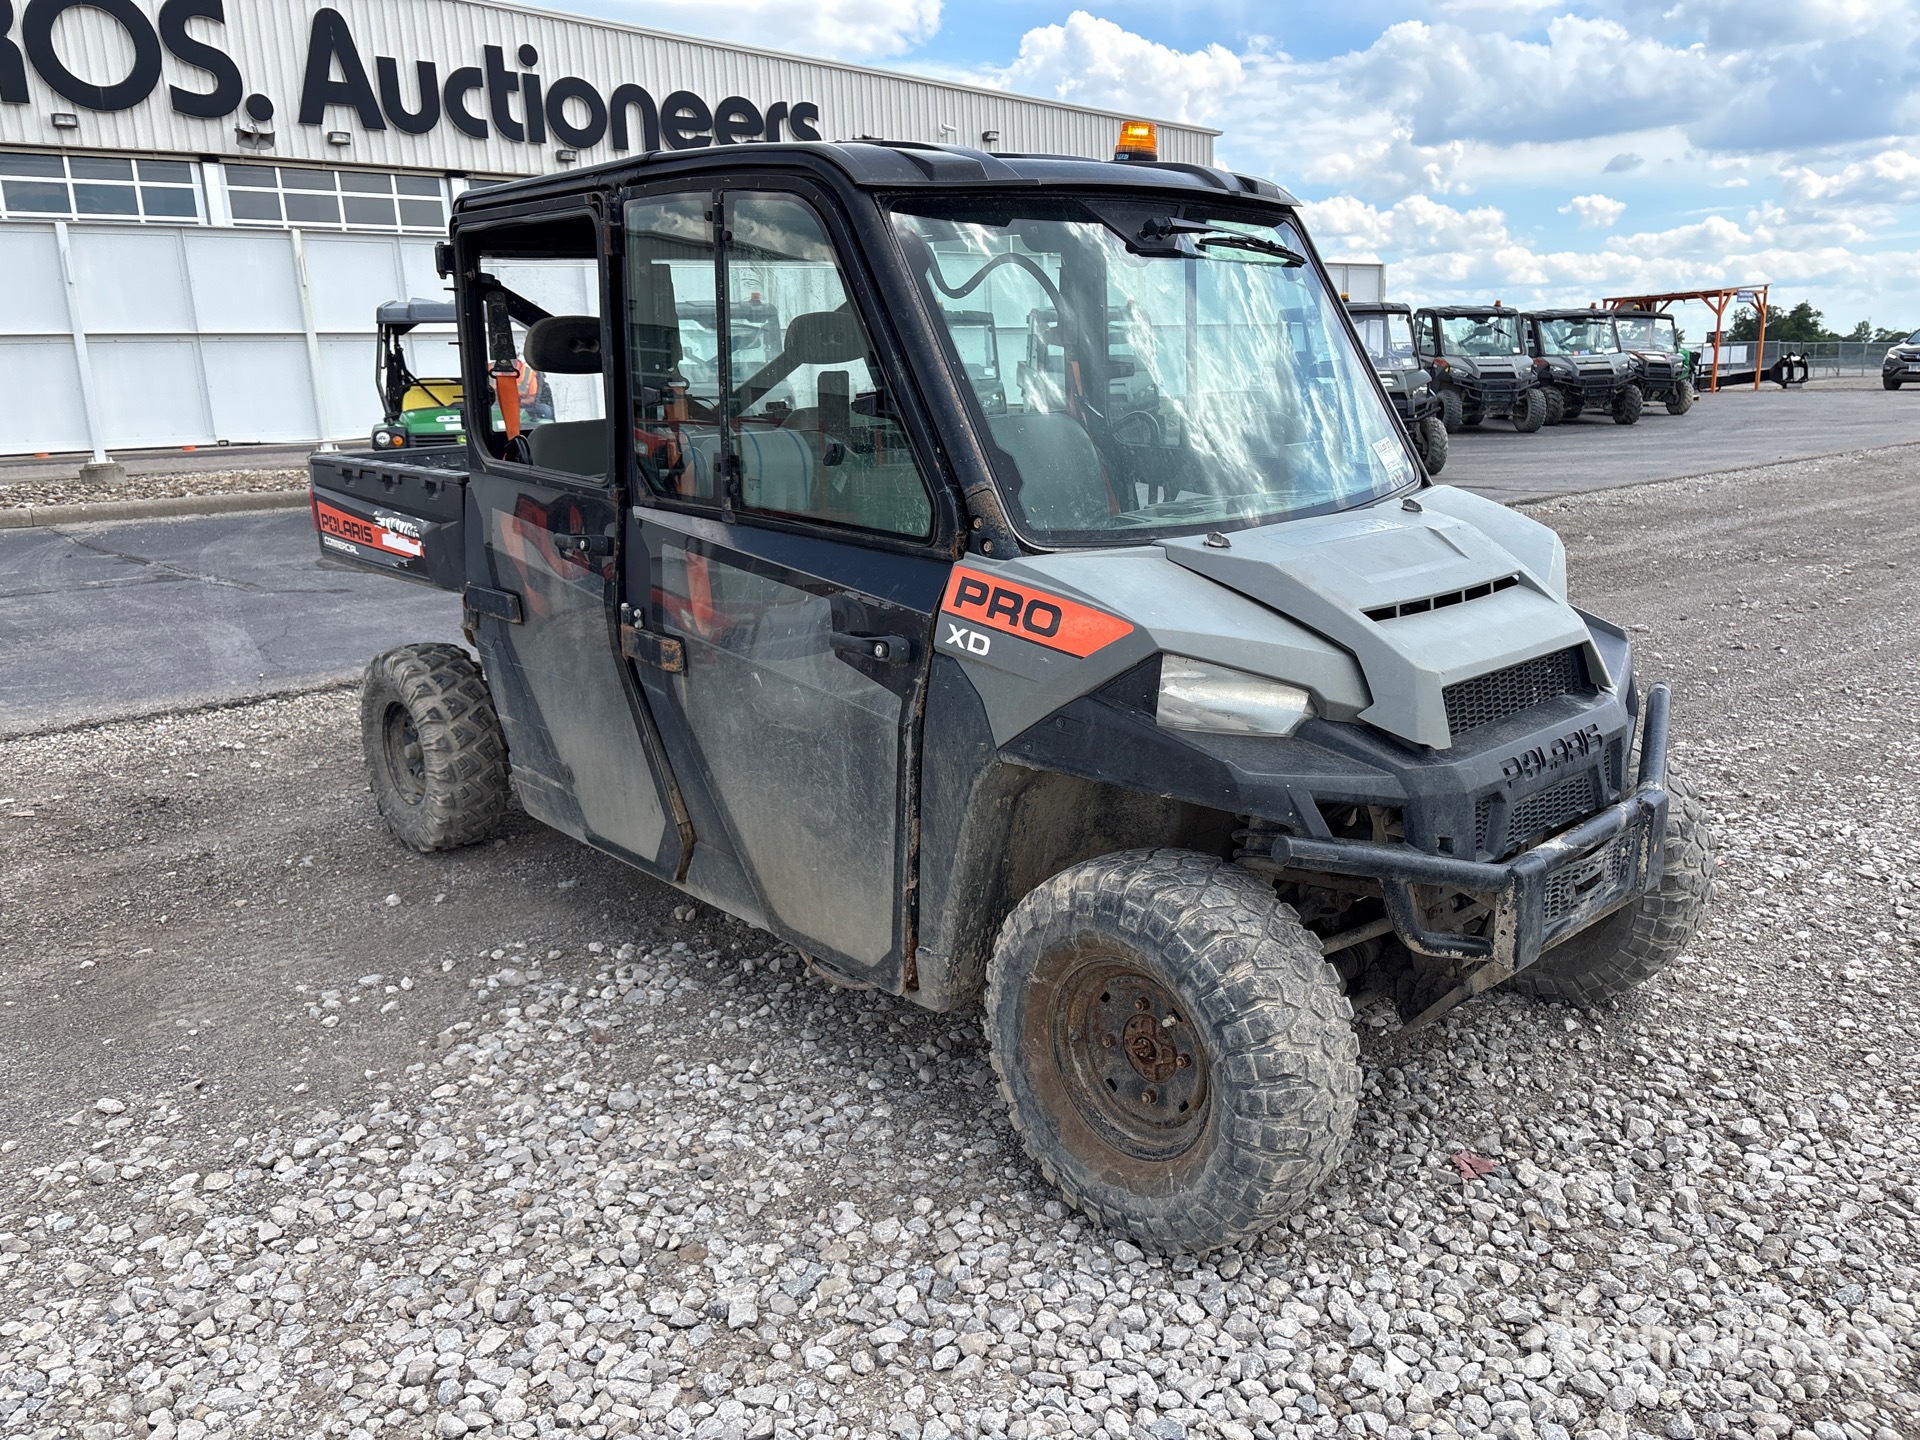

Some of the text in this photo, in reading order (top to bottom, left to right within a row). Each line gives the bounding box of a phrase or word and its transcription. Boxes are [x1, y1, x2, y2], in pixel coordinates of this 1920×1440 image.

[0, 0, 820, 151] OS. Auctioneers
[321, 513, 373, 543] POLARIS
[953, 576, 1063, 638] PRO
[945, 623, 991, 656] XD
[1500, 723, 1603, 788] POLARIS
